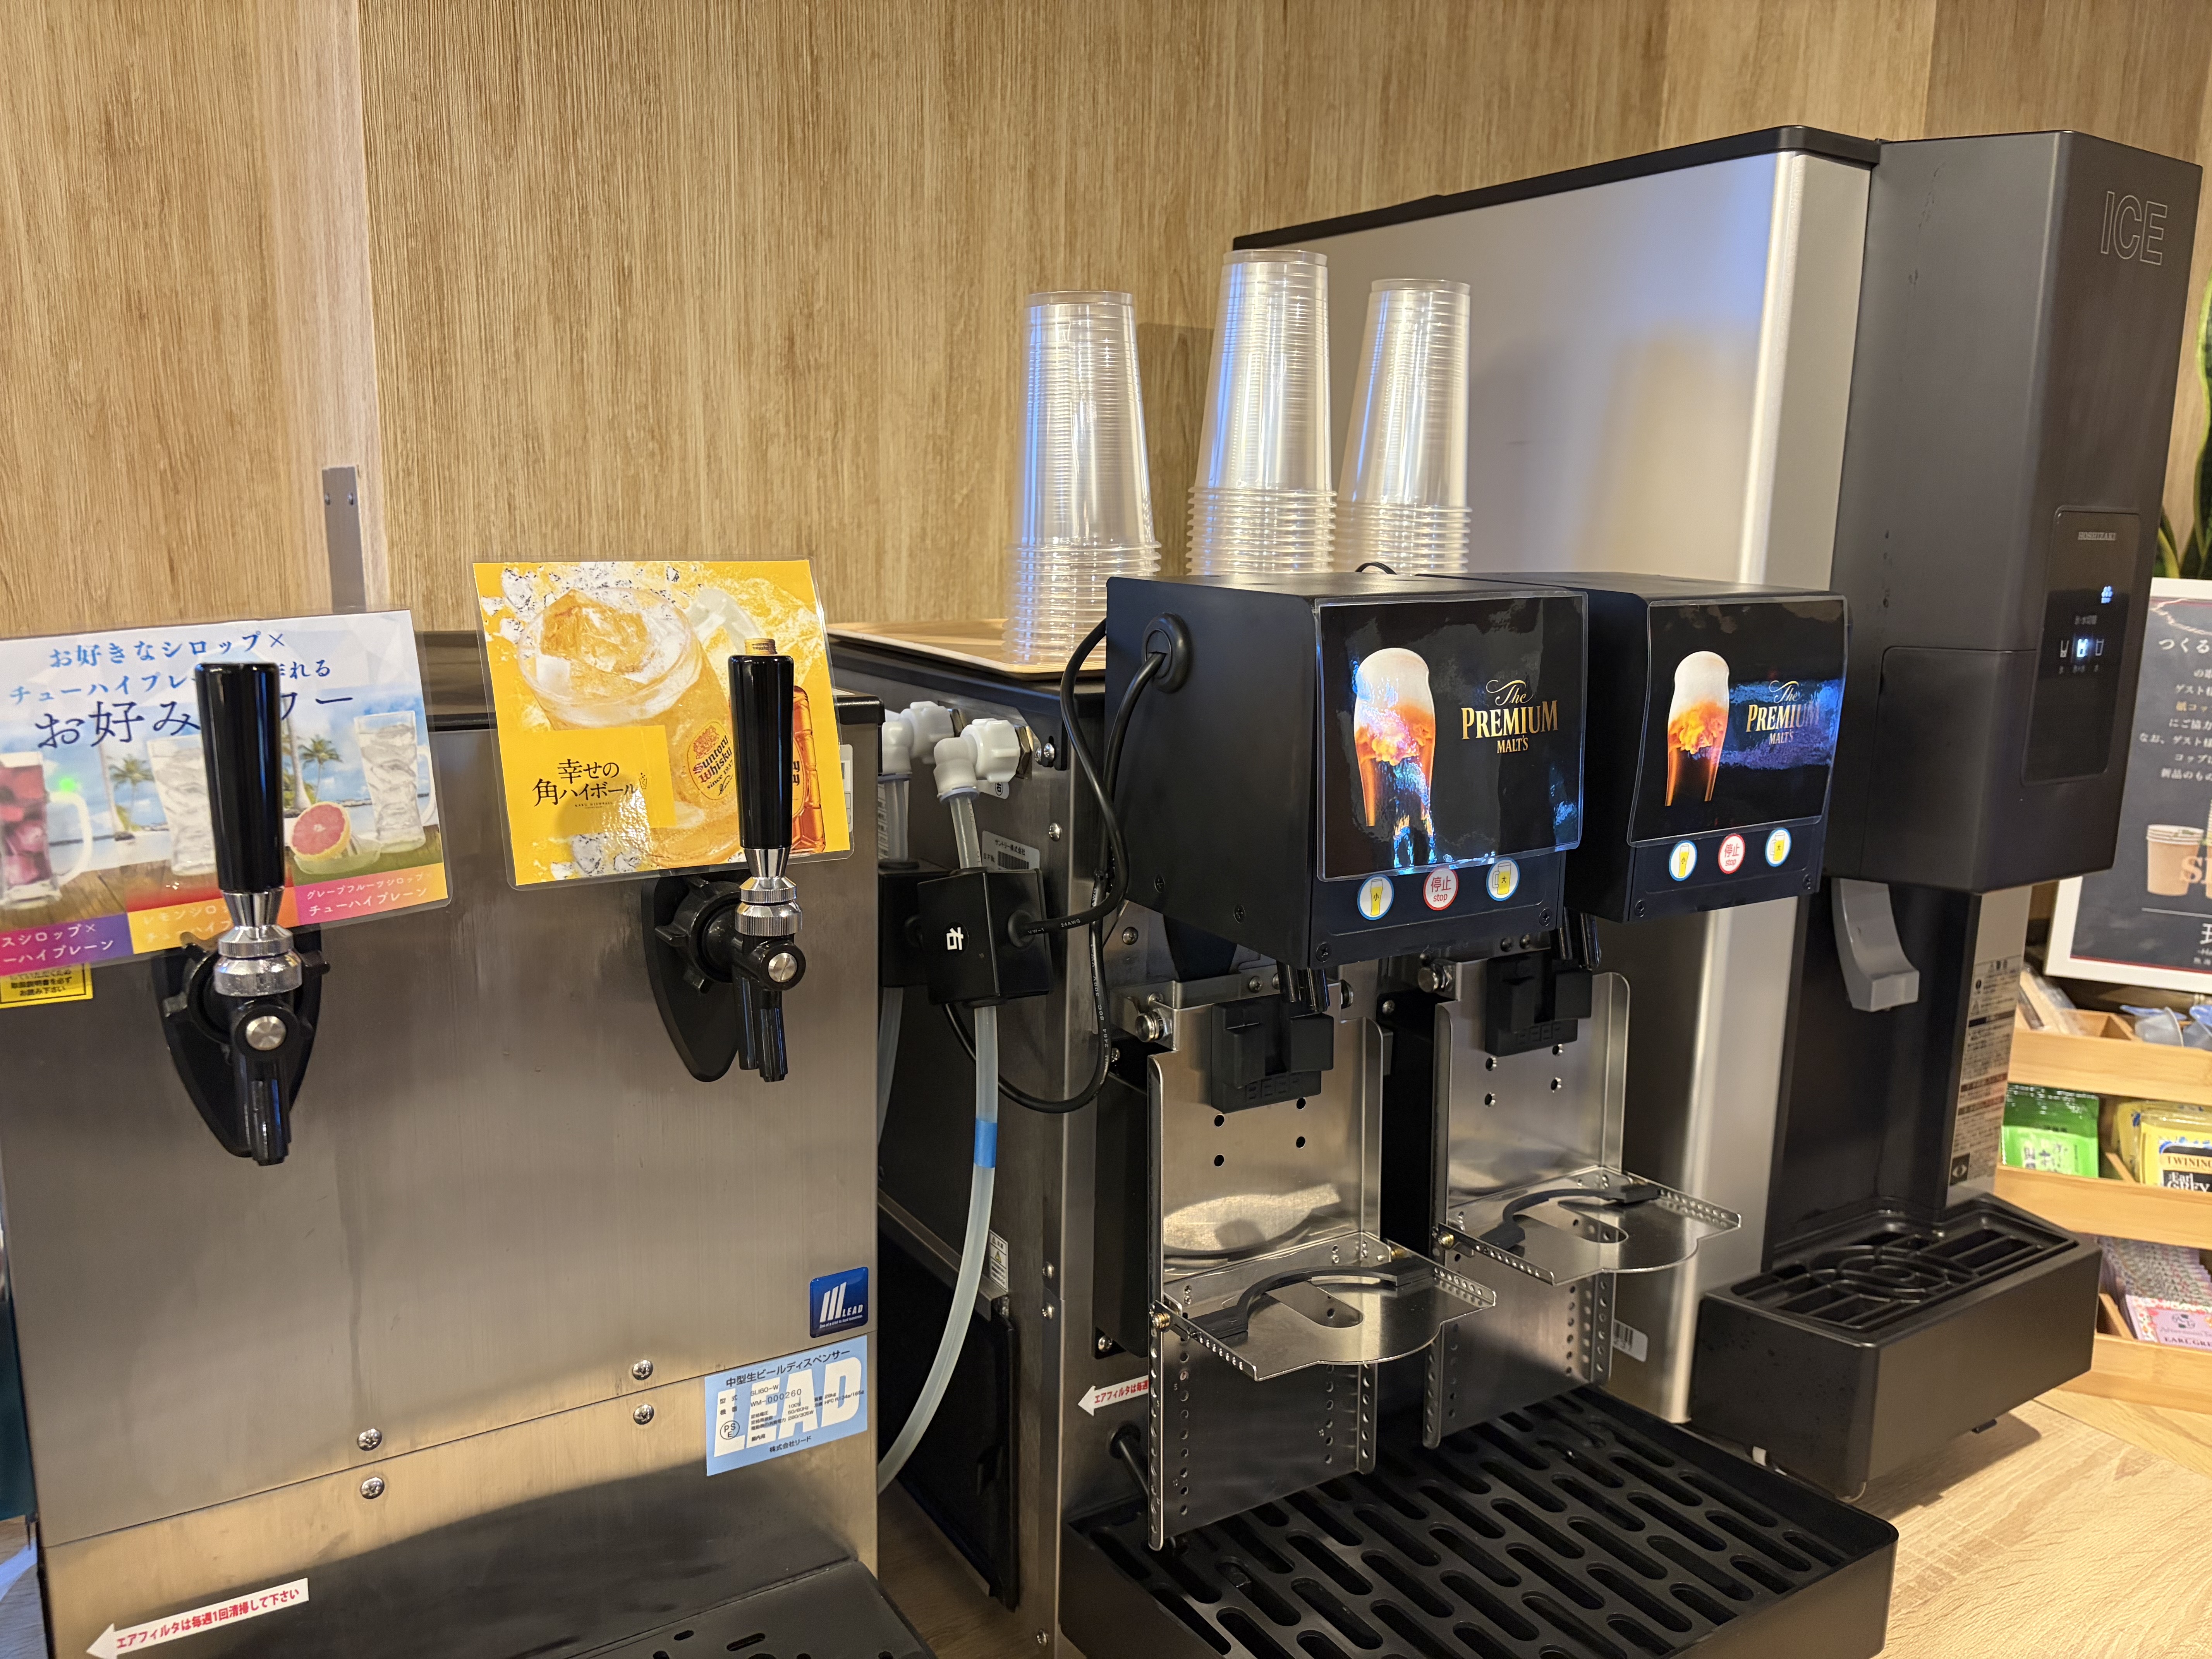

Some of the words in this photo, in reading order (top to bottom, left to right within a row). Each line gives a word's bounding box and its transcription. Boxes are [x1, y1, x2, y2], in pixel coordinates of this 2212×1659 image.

[2101, 191, 2167, 265] ICE
[2159, 637, 2210, 653] つくる
[10, 672, 196, 704] チューハイプレ
[1486, 680, 1534, 704] The
[1769, 680, 1802, 703] The
[35, 701, 201, 747] お好み
[1461, 701, 1558, 740] PREMIUM
[1746, 703, 1819, 732] PREMIUM
[1497, 736, 1528, 754] MALT'S
[1769, 729, 1794, 745] MALT'S
[693, 735, 728, 774] Suntory
[698, 747, 732, 783] Whisky
[557, 759, 619, 784] 幸せの
[707, 775, 723, 789] since
[723, 759, 733, 776] 1937
[532, 778, 638, 807] 角ハイボール
[1724, 843, 1739, 858] 停止
[1431, 876, 1451, 892] 停止
[309, 888, 427, 916] チューハイプレーン
[1374, 893, 1379, 901] 小
[1433, 894, 1448, 903] stop
[1060, 919, 1080, 927] 24AWG
[946, 927, 963, 950] 右
[2167, 1180, 2210, 1192] GREY
[2171, 1172, 2193, 1182] Earl
[842, 1304, 863, 1317] LEAD
[726, 1350, 850, 1387] 中型生ビールディスペンサー
[714, 1357, 862, 1457] LEAD
[750, 1389, 802, 1407] WM-000260
[770, 1435, 811, 1452] 株式会社リード
[117, 1588, 299, 1649] エアフィルタは毎週1回清掃して下さい
